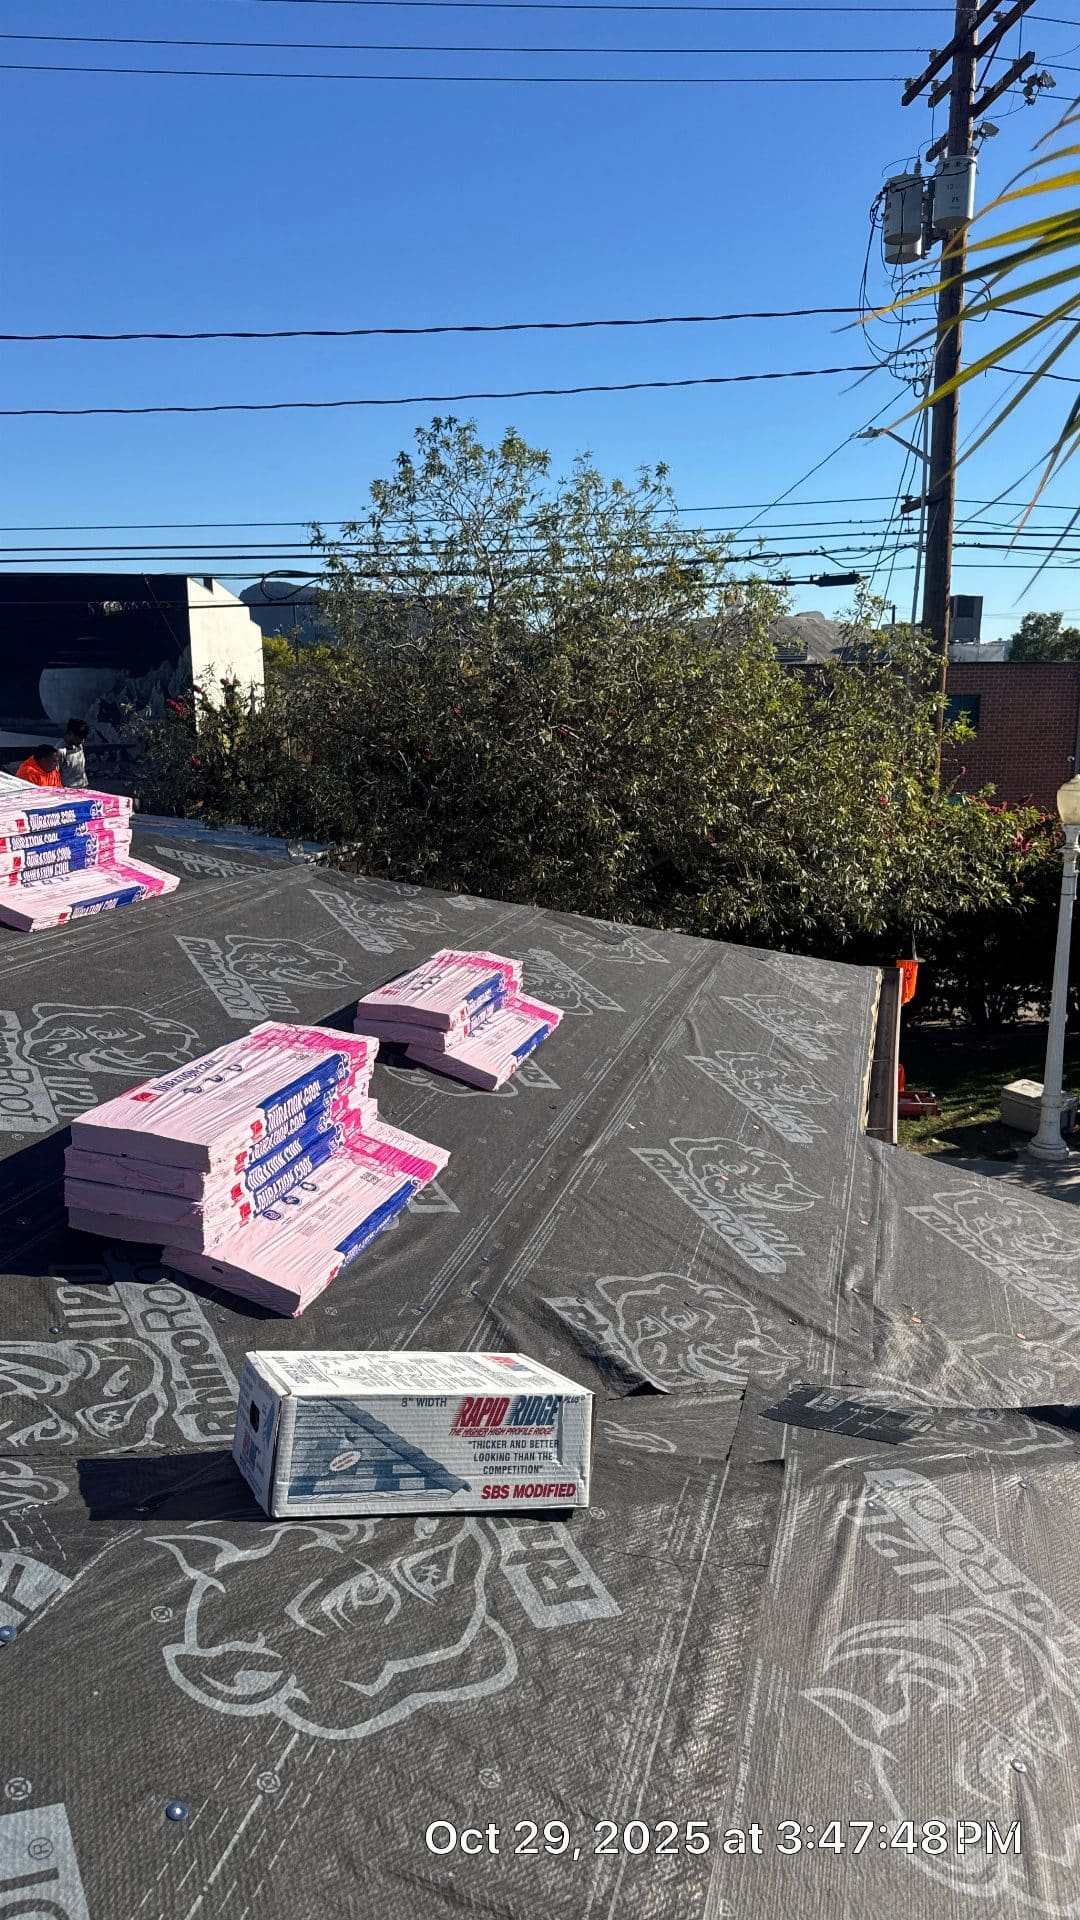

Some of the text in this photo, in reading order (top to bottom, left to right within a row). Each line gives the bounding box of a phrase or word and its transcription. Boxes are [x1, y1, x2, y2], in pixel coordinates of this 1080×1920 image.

[250, 983, 300, 1013] U20
[268, 1080, 321, 1131] DURATION COOL
[736, 1213, 806, 1256] U20
[416, 1397, 447, 1408] WIDTH
[452, 1396, 510, 1427] RAPID
[507, 1395, 561, 1426] RIDGE
[449, 1428, 462, 1436] THE
[462, 1428, 488, 1437] HIGHER
[487, 1428, 504, 1436] HIGH
[504, 1427, 533, 1436] PROFILE
[509, 1440, 527, 1449] AND
[529, 1440, 559, 1449] BETTER
[473, 1452, 553, 1462] LOOKING THAN THE
[481, 1484, 577, 1500] SBS MODIFIED
